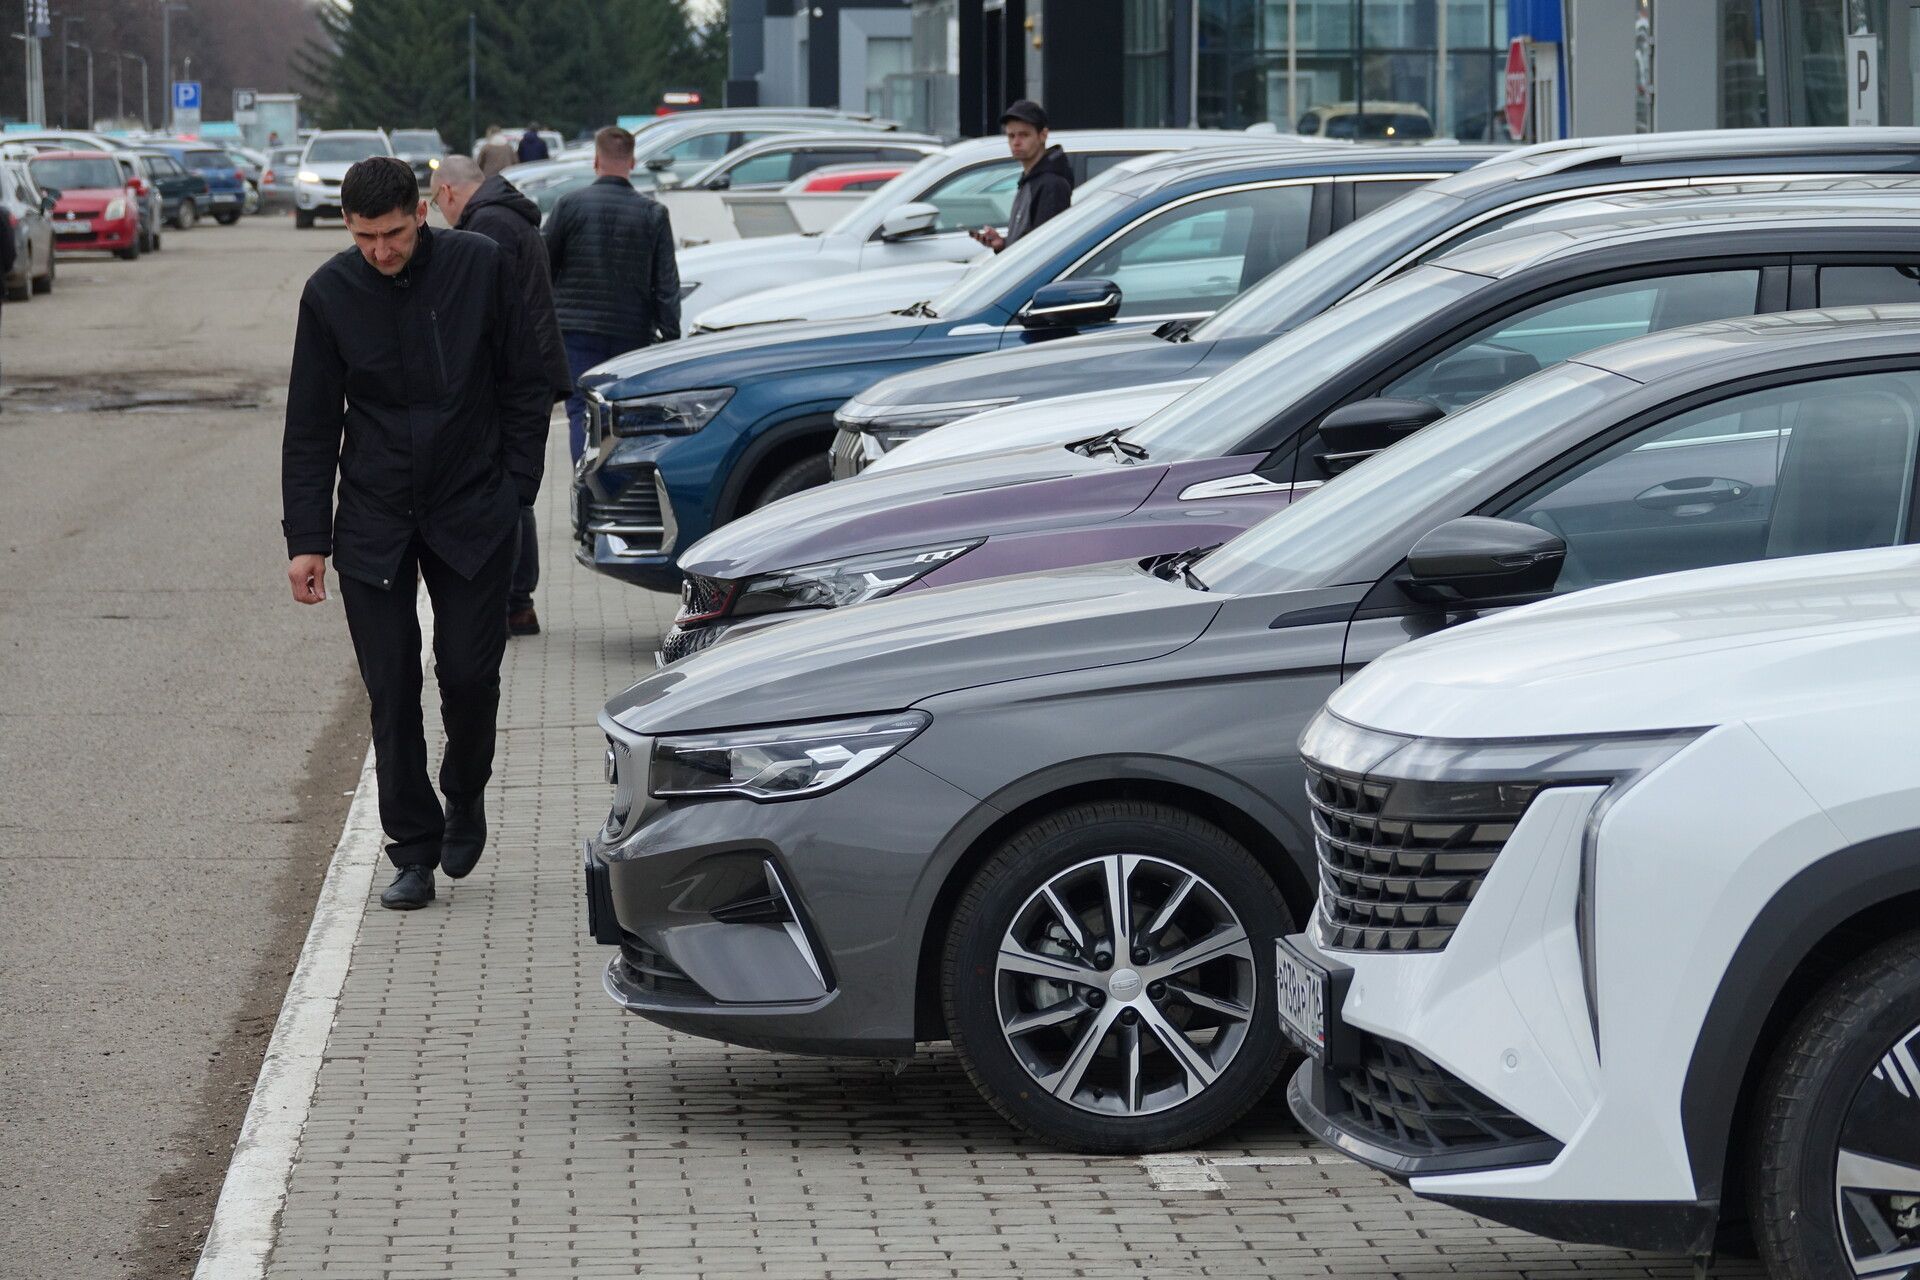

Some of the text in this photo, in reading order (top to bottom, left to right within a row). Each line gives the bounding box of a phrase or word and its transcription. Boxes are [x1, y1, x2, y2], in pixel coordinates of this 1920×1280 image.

[1507, 73, 1526, 105] STOP
[1856, 50, 1869, 110] P
[178, 83, 196, 109] P
[238, 92, 253, 110] P
